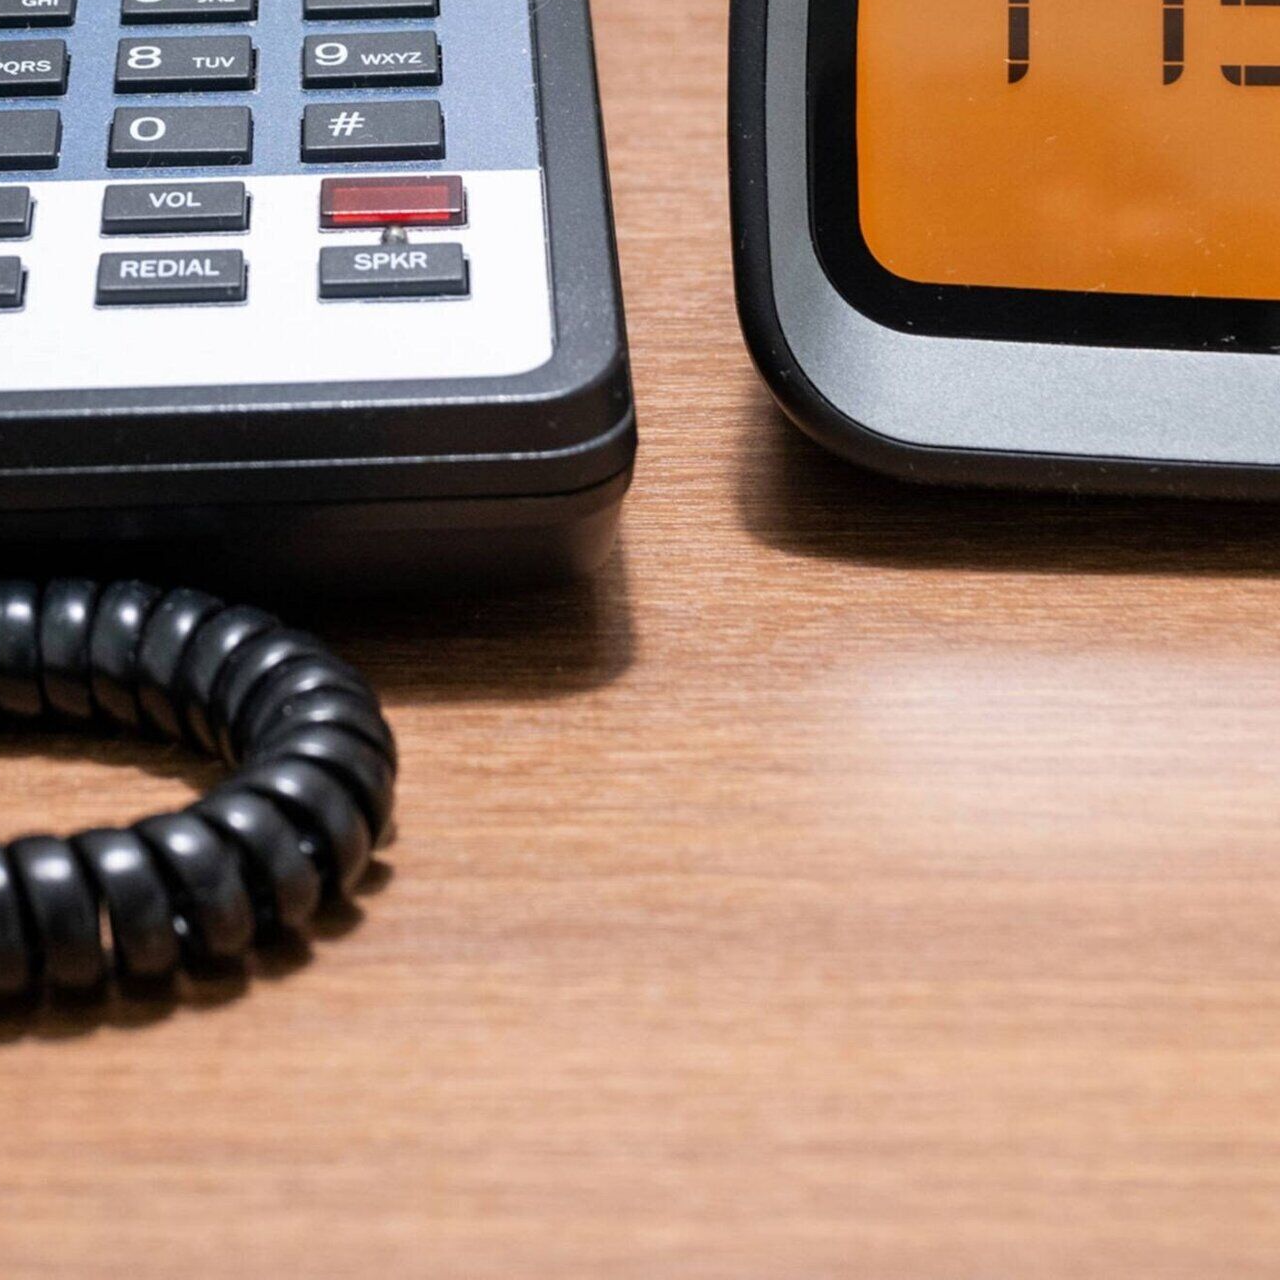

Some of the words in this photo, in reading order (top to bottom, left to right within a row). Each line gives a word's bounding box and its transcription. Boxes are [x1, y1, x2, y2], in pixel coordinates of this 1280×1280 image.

[127, 45, 162, 70] 8
[191, 56, 236, 69] TUV
[314, 42, 349, 66] 9
[360, 51, 422, 66] WXYZ
[129, 116, 167, 142] 0
[327, 111, 366, 137] #
[148, 191, 202, 208] VOL
[119, 258, 220, 279] REDIAL
[353, 251, 428, 271] SPKR
